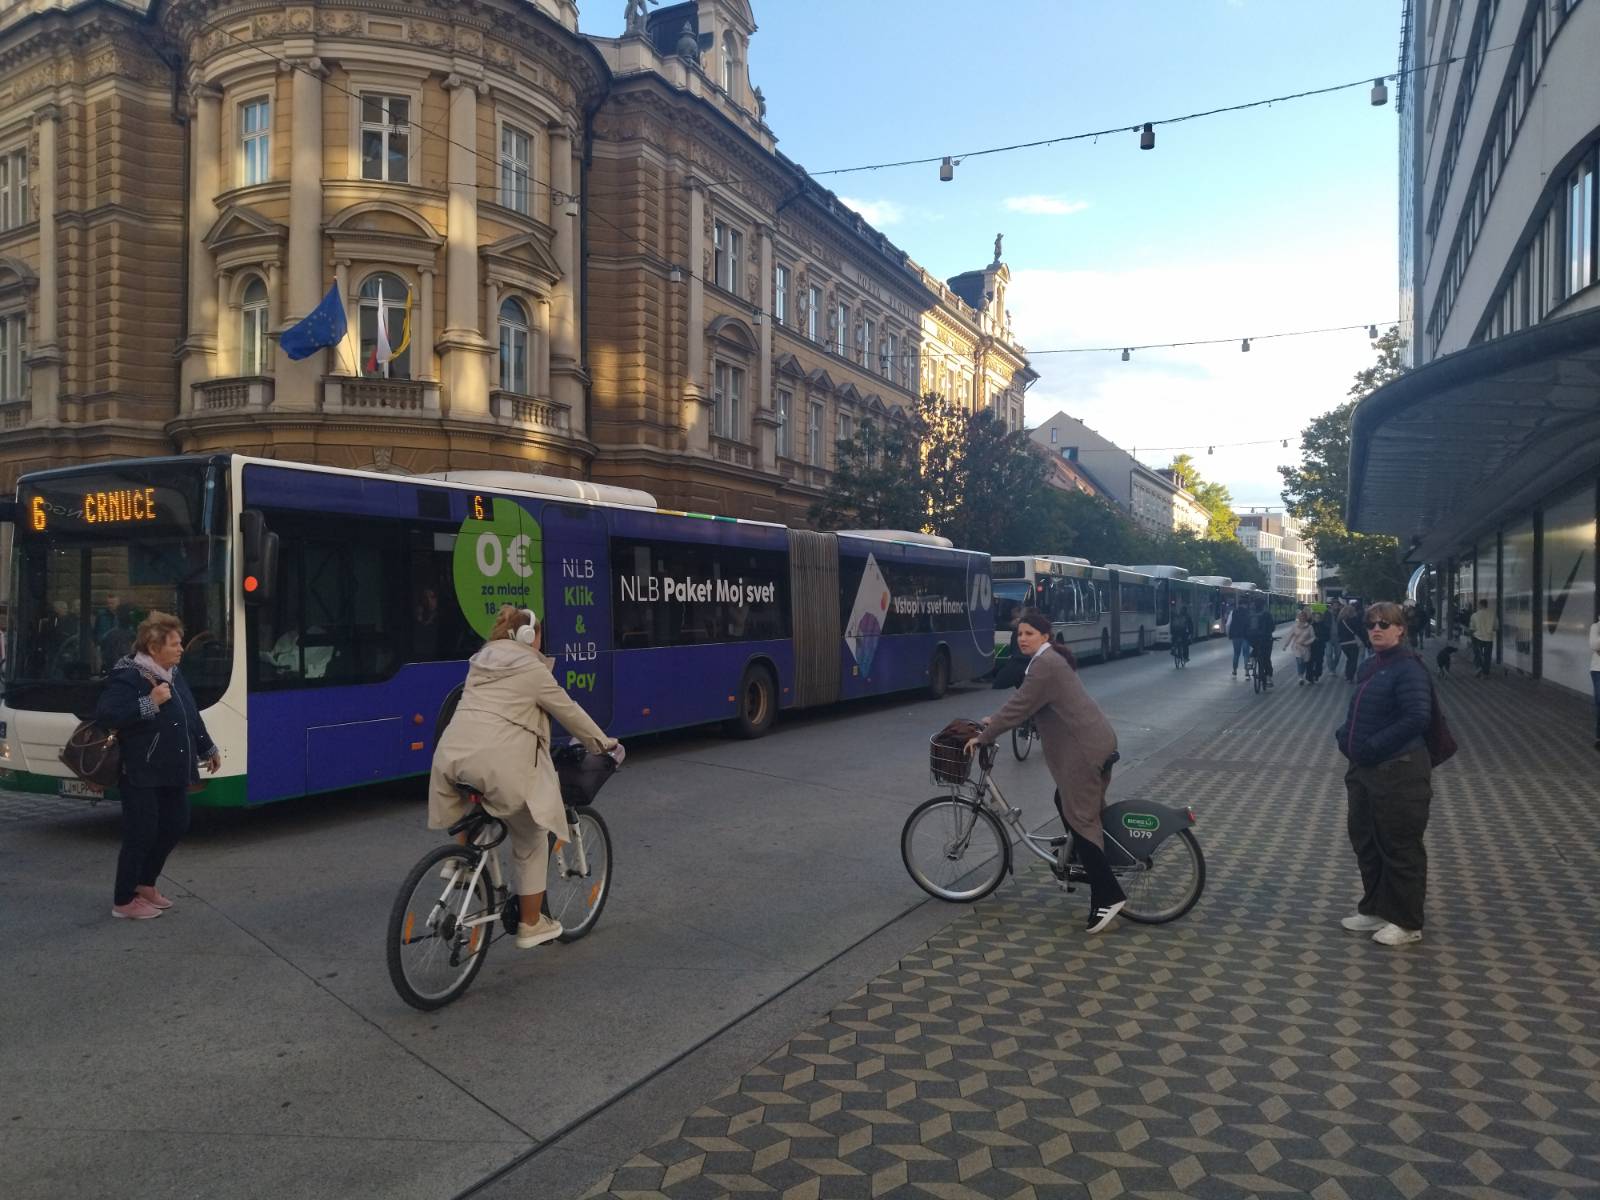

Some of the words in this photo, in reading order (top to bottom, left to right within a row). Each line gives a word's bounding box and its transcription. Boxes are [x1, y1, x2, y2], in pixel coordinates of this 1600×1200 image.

[32, 496, 46, 530] 6
[474, 495, 484, 520] 6
[562, 558, 595, 579] NLB
[481, 586, 494, 596] za
[497, 583, 530, 596] mlade
[563, 585, 595, 607] Klik
[620, 575, 659, 602] NLB
[663, 577, 712, 602] Paket
[716, 578, 743, 608] Moj
[746, 582, 775, 603] svet
[575, 613, 586, 634] &
[565, 642, 597, 662] NLB
[566, 670, 597, 692] Pay
[1129, 830, 1153, 839] 1079
